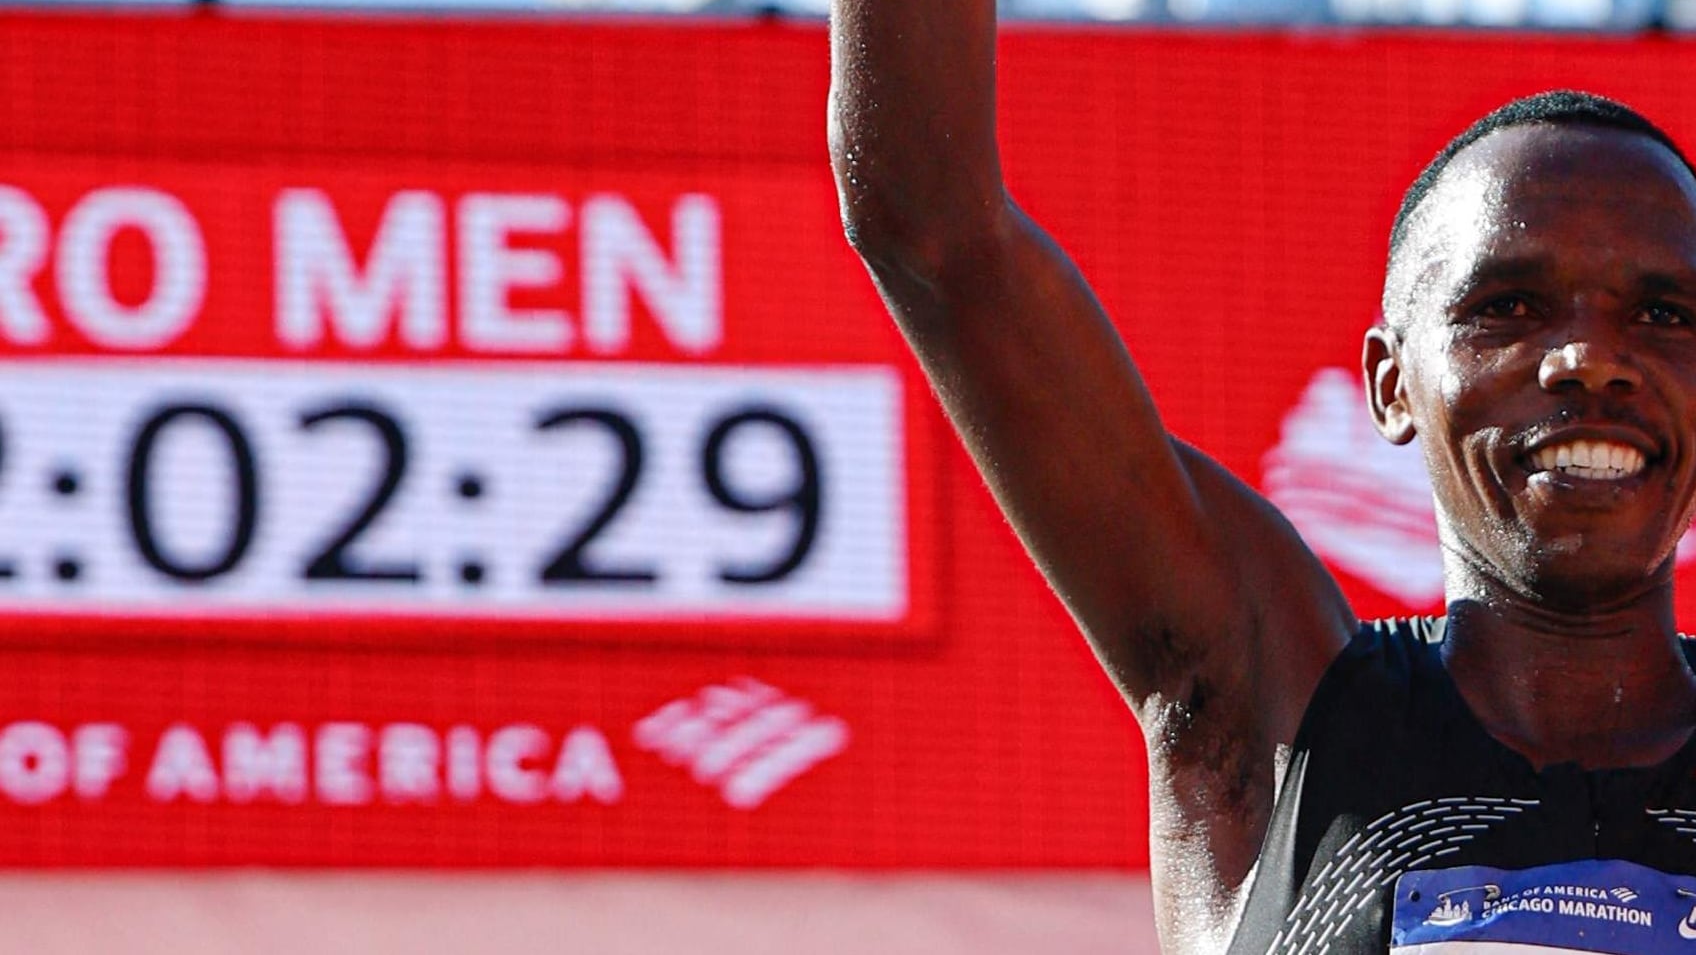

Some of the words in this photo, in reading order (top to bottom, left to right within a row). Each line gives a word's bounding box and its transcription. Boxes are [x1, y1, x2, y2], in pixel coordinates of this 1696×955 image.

[272, 188, 723, 354] MEN
[0, 396, 829, 587] :02:29
[0, 721, 127, 804] OF
[146, 722, 623, 805] AMERICA
[1543, 886, 1608, 900] AMERICA
[1558, 899, 1652, 927] MARATHON
